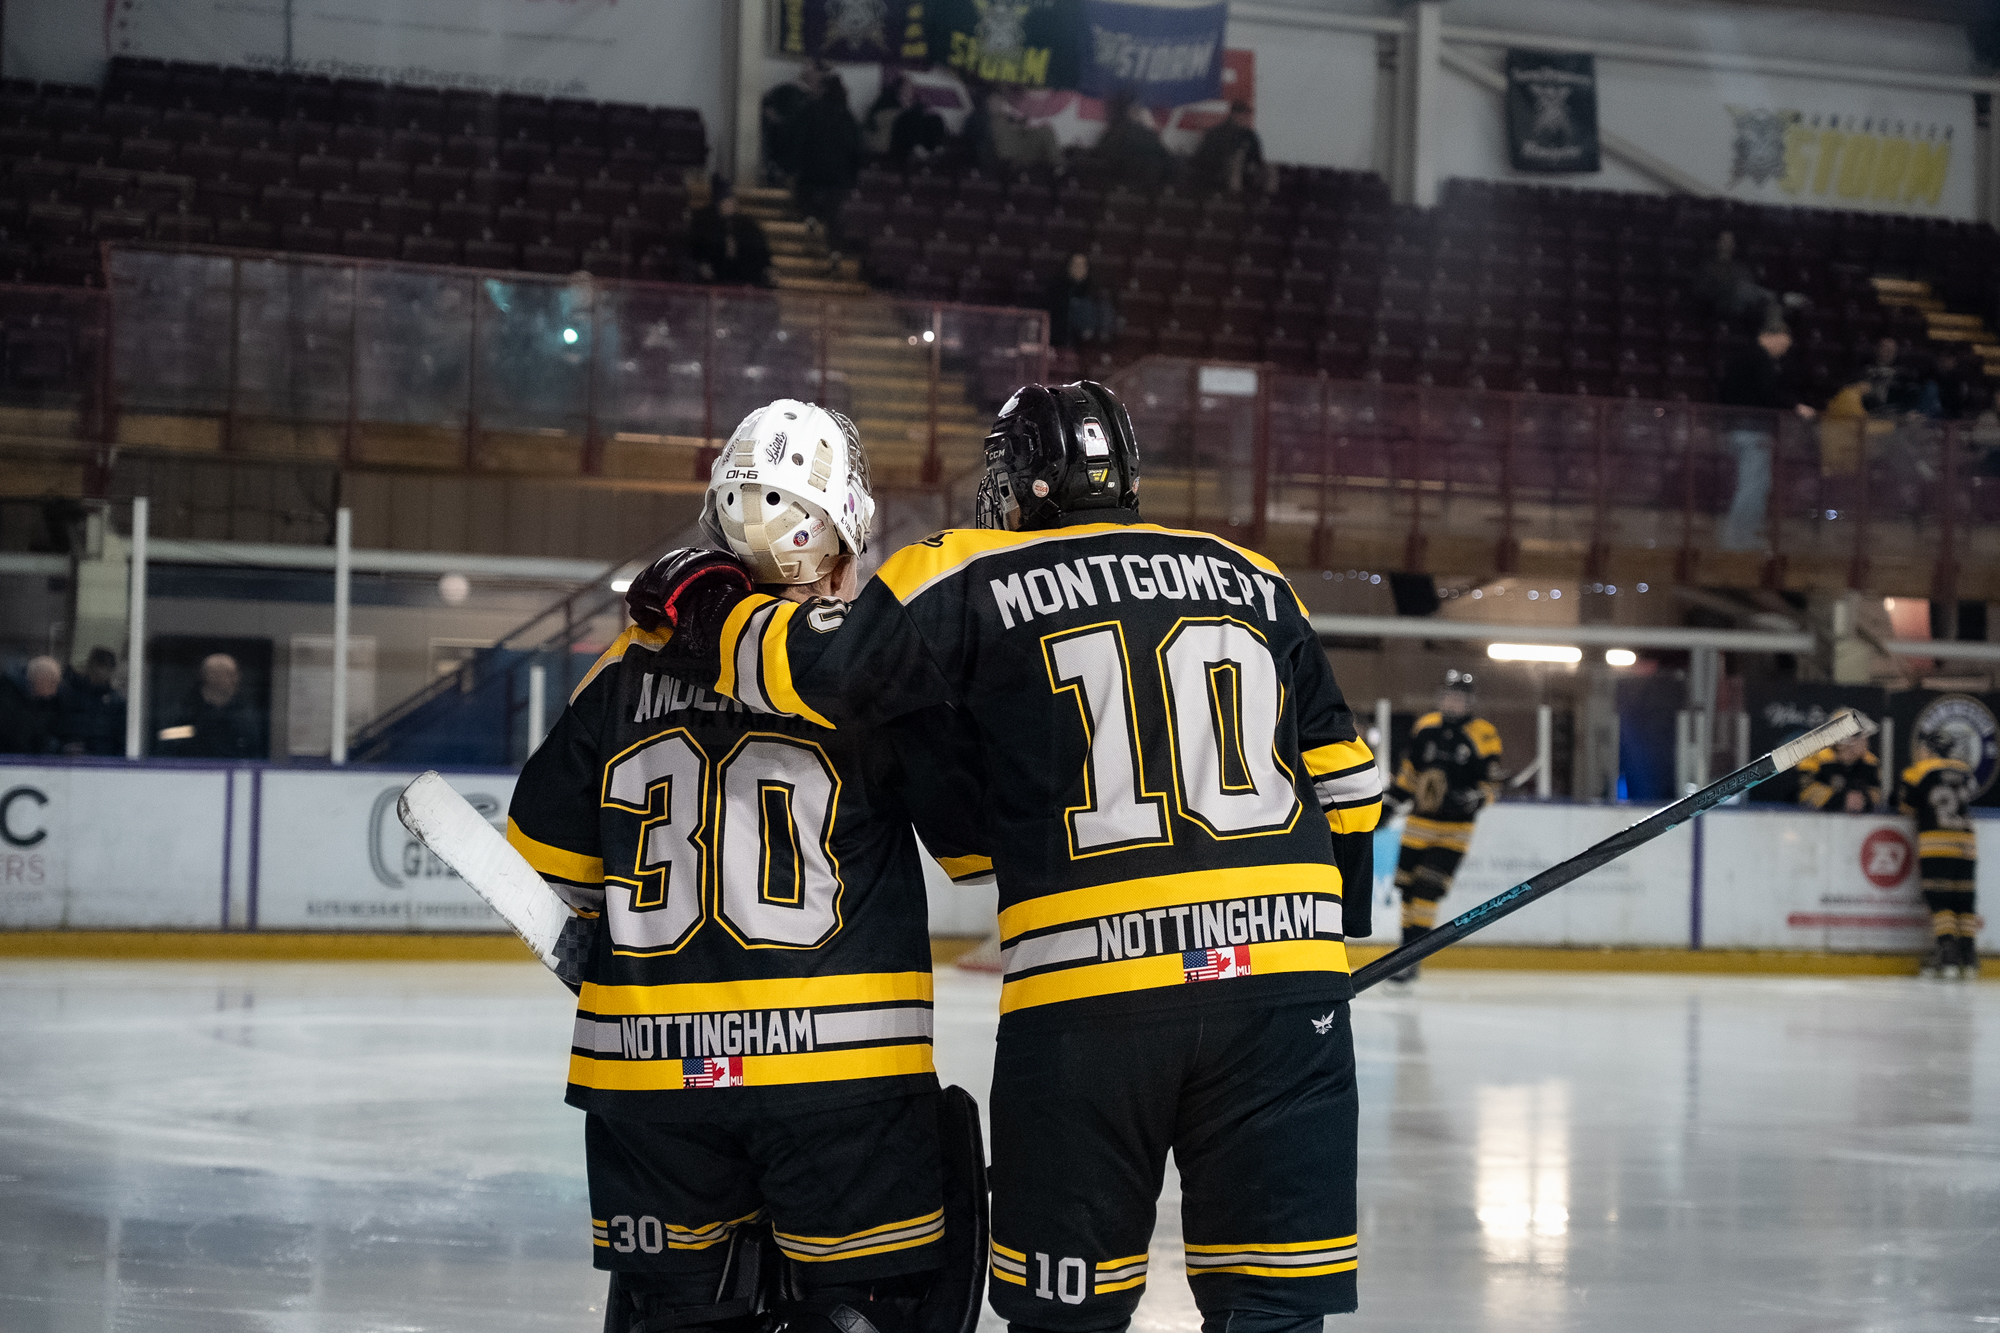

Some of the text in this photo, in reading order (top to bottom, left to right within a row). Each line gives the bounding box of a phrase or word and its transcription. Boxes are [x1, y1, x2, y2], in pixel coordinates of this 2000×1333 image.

[1780, 127, 1951, 207] STORM
[989, 448, 1005, 461] CCM
[989, 553, 1278, 630] MONTGOMERY
[1040, 614, 1304, 861] 10
[1696, 772, 1748, 807] BAUER
[600, 726, 845, 958] 30
[1099, 894, 1314, 962] NOTTINGHAM
[1186, 964, 1251, 982] AJ MU
[622, 1009, 814, 1059] NOTTINGHAM
[685, 1075, 743, 1088] AJ MU
[611, 1215, 664, 1254] 30
[1035, 1251, 1087, 1305] 10
